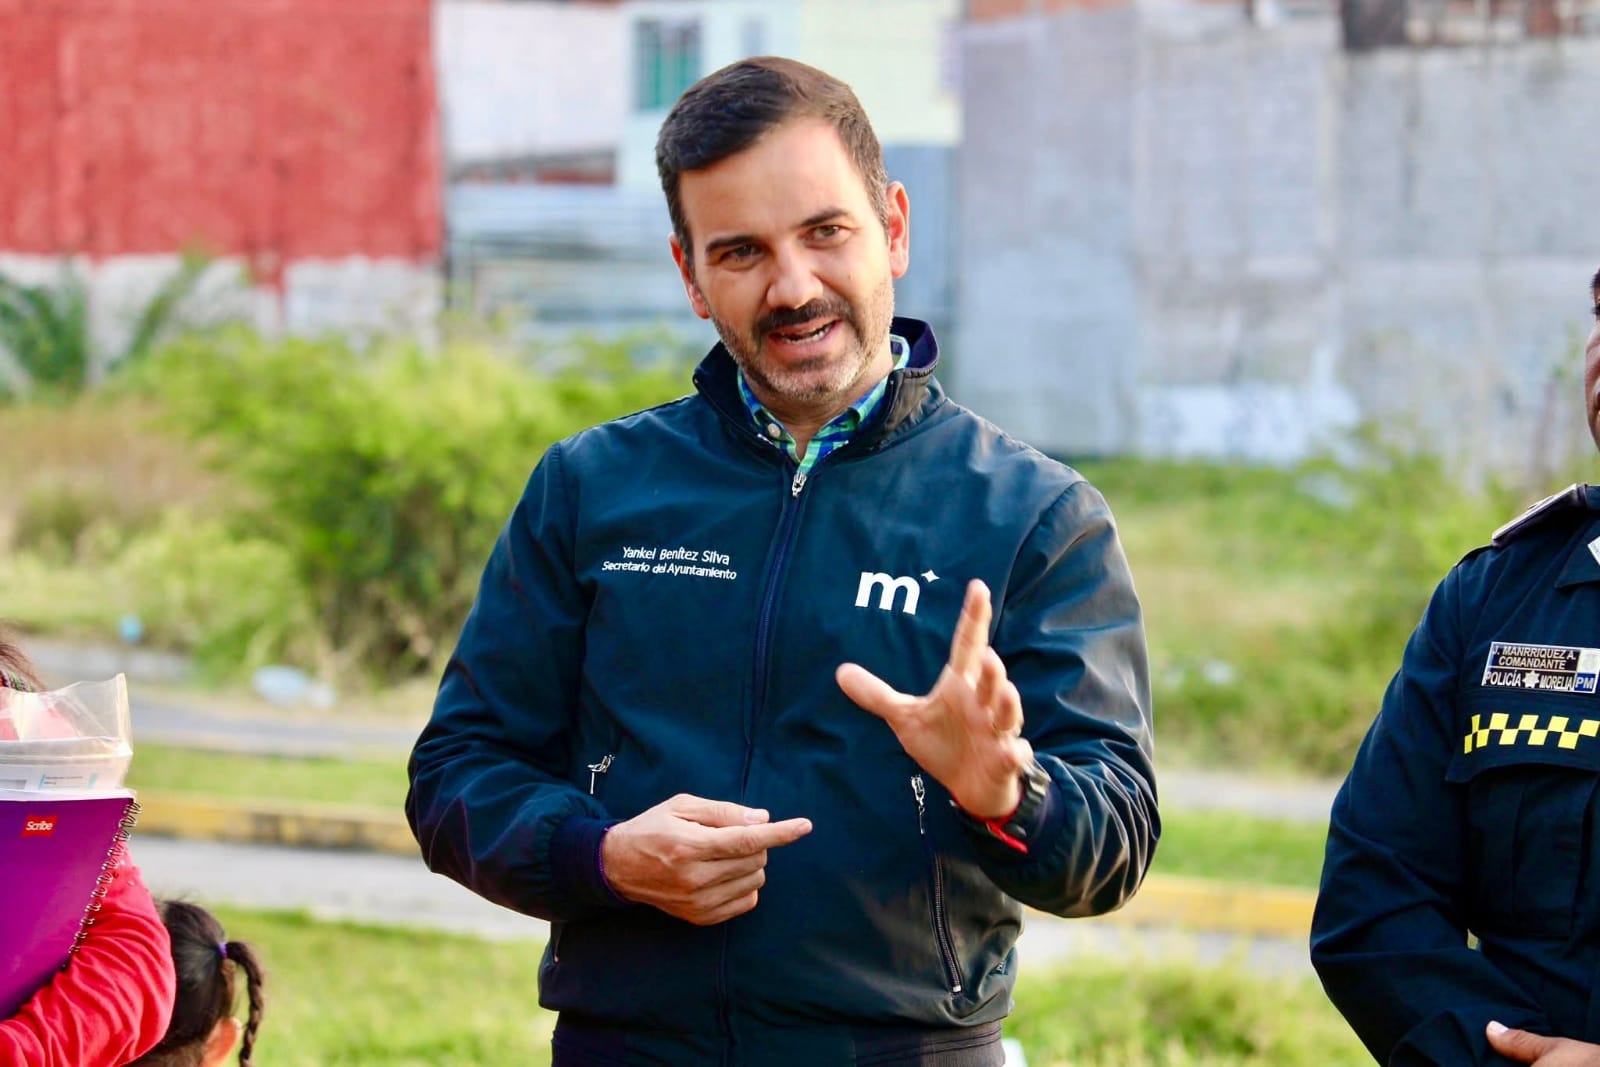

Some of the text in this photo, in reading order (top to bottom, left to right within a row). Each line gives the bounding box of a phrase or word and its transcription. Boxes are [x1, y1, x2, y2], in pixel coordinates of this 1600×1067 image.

[622, 546, 656, 560] Yankel
[701, 550, 730, 565] Silva
[601, 561, 737, 580] Secretario del Ayuntamiento
[1492, 645, 1577, 660] J. MANRRIQUEZ A.
[1498, 656, 1567, 670] COMANDANTE
[1484, 670, 1574, 690] POLICÍA MORELIA
[1574, 677, 1595, 690] PM
[25, 820, 54, 831] Scribe
